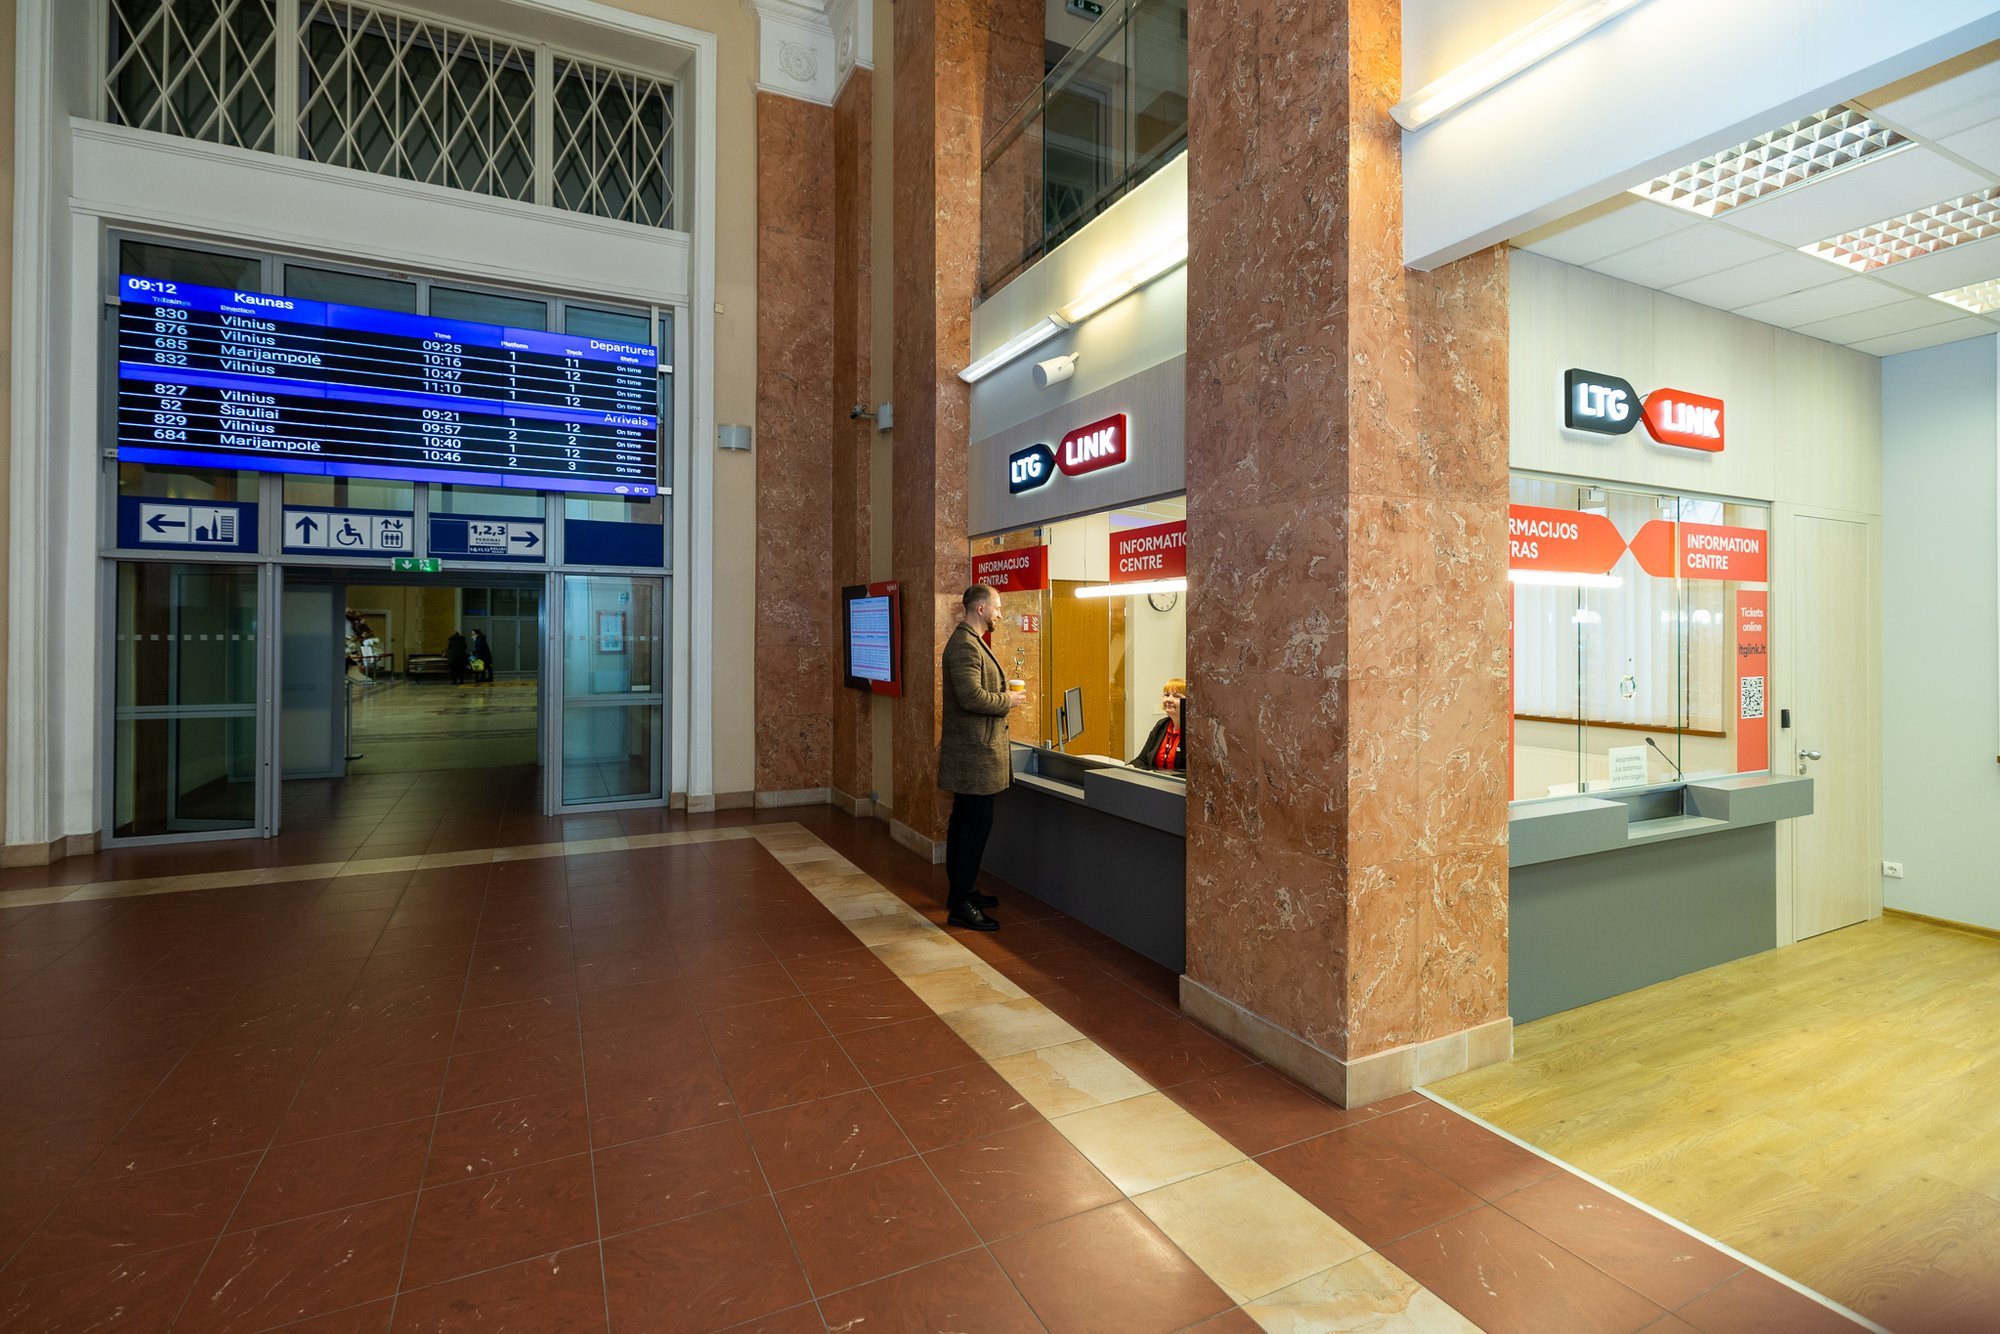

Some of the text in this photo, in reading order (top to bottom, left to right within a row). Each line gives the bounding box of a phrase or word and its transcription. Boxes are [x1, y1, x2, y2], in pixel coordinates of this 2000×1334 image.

[128, 278, 177, 294] 09:12
[234, 292, 294, 310] Kaunas
[154, 307, 188, 321] 830
[220, 314, 276, 332] Vilnius
[422, 340, 462, 354] 09:25
[509, 352, 516, 360] 1
[565, 358, 580, 368] 11
[434, 332, 452, 340] Time
[154, 322, 188, 336] 876
[220, 329, 276, 346] Vilnius
[423, 354, 462, 367] 10:16
[509, 364, 516, 374] 1
[565, 371, 581, 381] 12
[590, 340, 655, 357] Departures
[154, 337, 188, 350] 685
[220, 344, 322, 366] Marijampolė
[422, 368, 462, 380] 10:47
[509, 378, 516, 387] 1
[569, 384, 576, 393] 1
[154, 352, 188, 366] 832
[220, 359, 276, 374] Vilnius
[422, 382, 462, 394] 11:10
[509, 390, 516, 400] 1
[565, 396, 581, 406] 12
[154, 383, 188, 396] 827
[220, 389, 276, 405] Vilnius
[422, 409, 460, 422] 09:21
[509, 418, 516, 427] 1
[565, 423, 581, 432] 12
[1579, 382, 1720, 438] LTG LINK
[160, 398, 183, 411] 52
[220, 402, 280, 420] Šiauliai
[422, 422, 462, 435] 09:57
[508, 431, 518, 440] 2
[568, 436, 577, 446] 2
[604, 414, 649, 426] Arrivals
[154, 414, 188, 426] 829
[220, 418, 276, 434] Vilnius
[422, 436, 462, 448] 10:40
[509, 444, 516, 453] 1
[565, 449, 581, 458] 12
[154, 429, 188, 441] 684
[220, 434, 321, 452] Marijampolė
[422, 450, 462, 462] 10:46
[508, 456, 518, 466] 2
[568, 462, 576, 470] 3
[1011, 426, 1116, 484] LTG LINK
[471, 525, 506, 536] 1,2,3
[1508, 540, 1539, 558] RAS
[1688, 534, 1758, 554] INFORMATION
[978, 556, 1030, 574] INFORMACIJOS
[1120, 554, 1163, 572] CENTRE
[1688, 553, 1728, 570] CENTRE
[978, 574, 1008, 586] CENTRAS
[1740, 608, 1764, 618] Tickets
[1742, 622, 1762, 632] online
[1738, 644, 1766, 657] ltglink.lt
